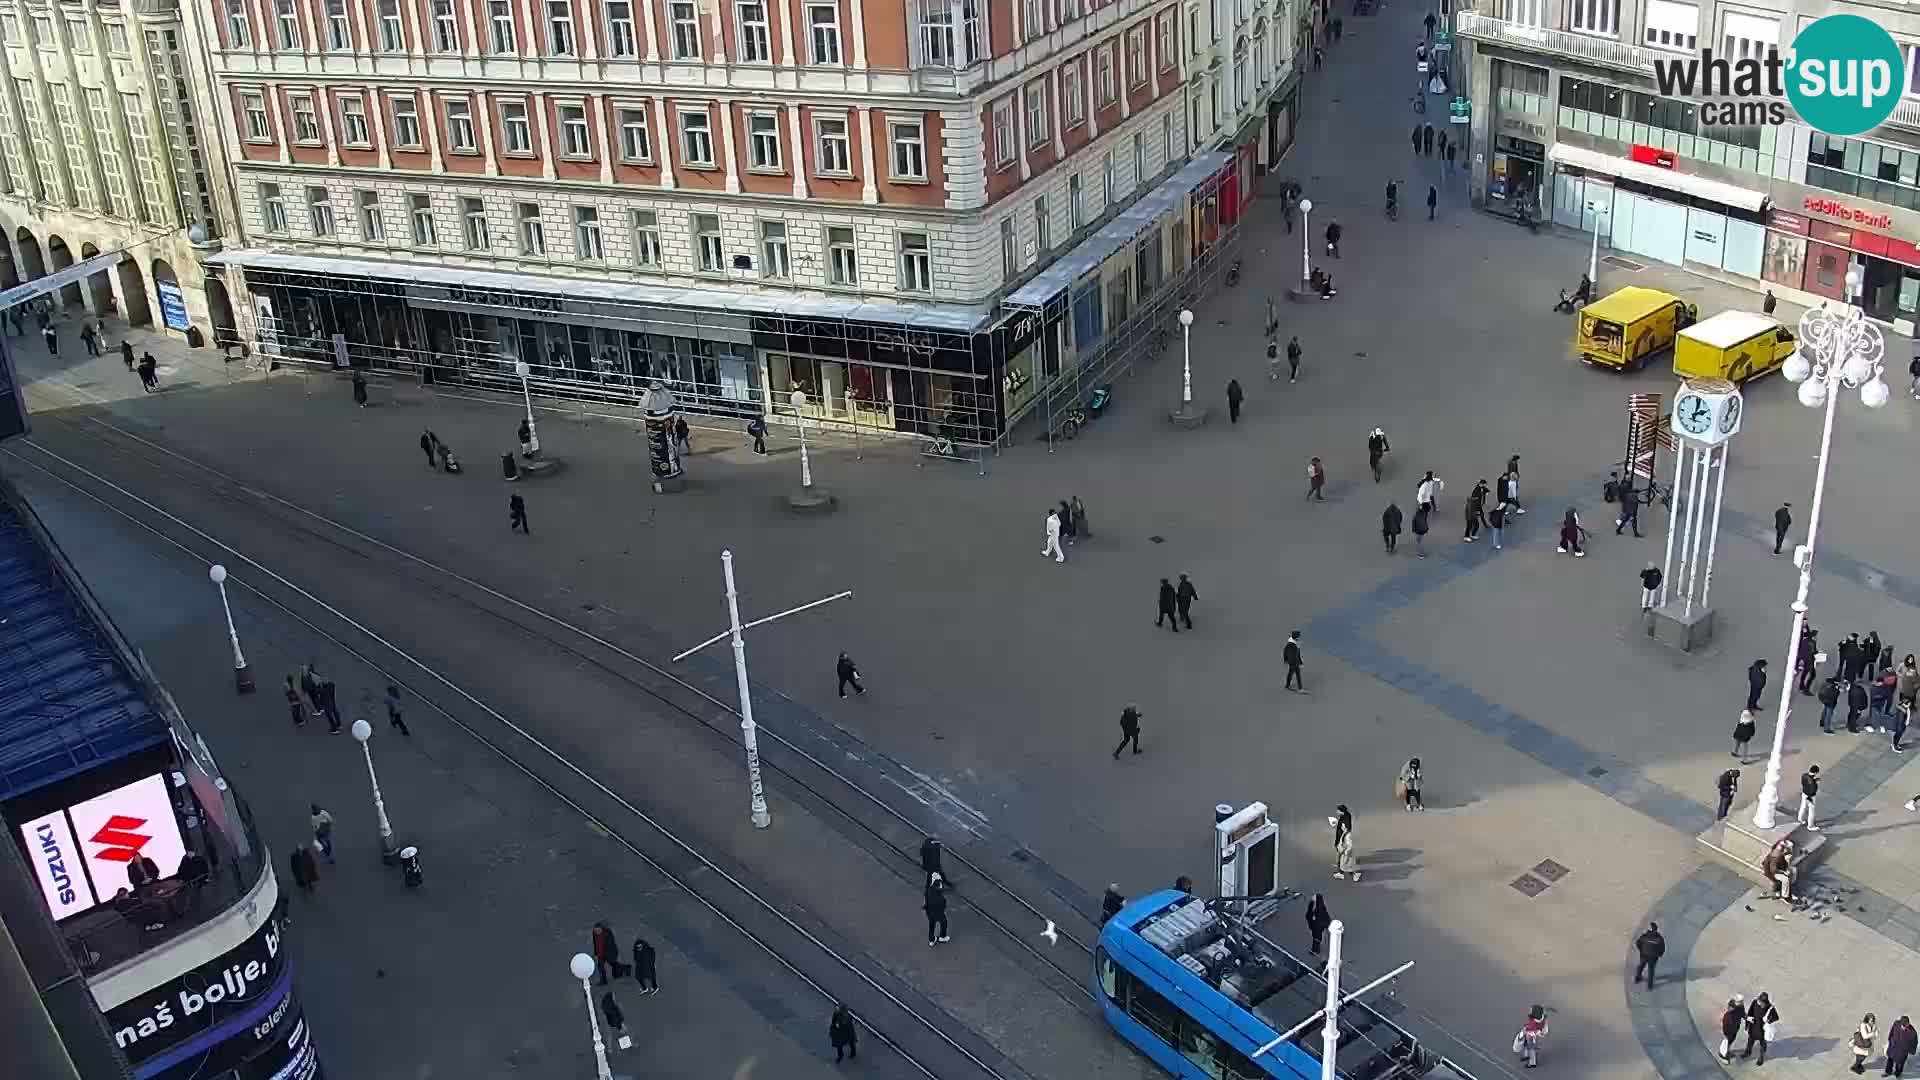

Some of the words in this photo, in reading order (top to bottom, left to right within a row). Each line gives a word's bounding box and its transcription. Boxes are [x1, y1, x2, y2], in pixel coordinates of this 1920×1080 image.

[1854, 210, 1892, 228] Bank
[36, 823, 76, 905] SUZUKI
[115, 1001, 174, 1048] naš
[179, 960, 266, 1016] bolje,
